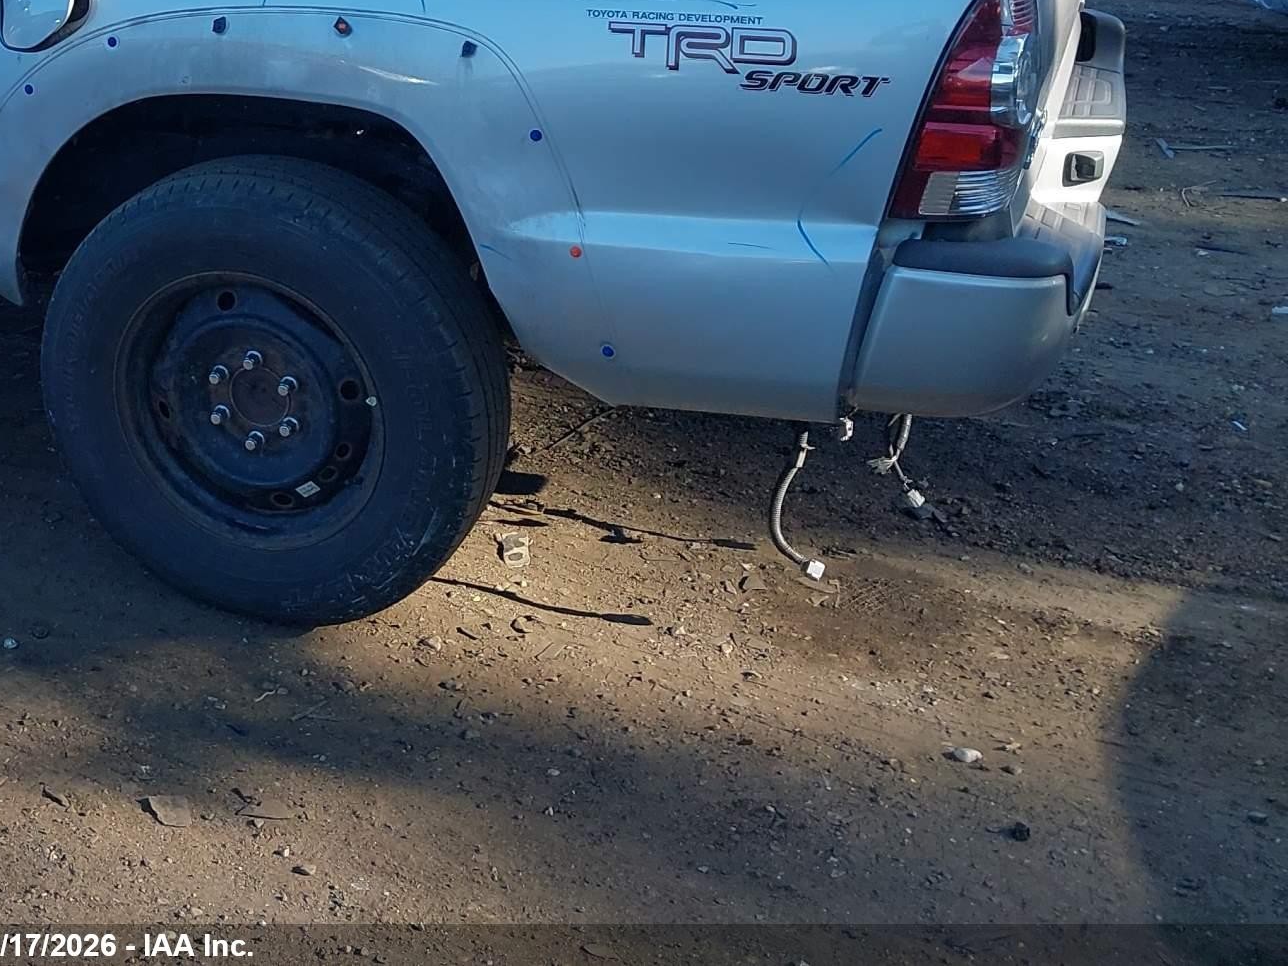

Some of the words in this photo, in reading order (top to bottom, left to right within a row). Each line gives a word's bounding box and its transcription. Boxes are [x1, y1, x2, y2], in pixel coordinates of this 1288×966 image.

[586, 9, 628, 20] TOYOTA
[632, 11, 674, 22] RACING
[678, 13, 764, 25] DEVELOPMENT
[608, 21, 798, 74] TRD
[740, 70, 891, 97] SPORT
